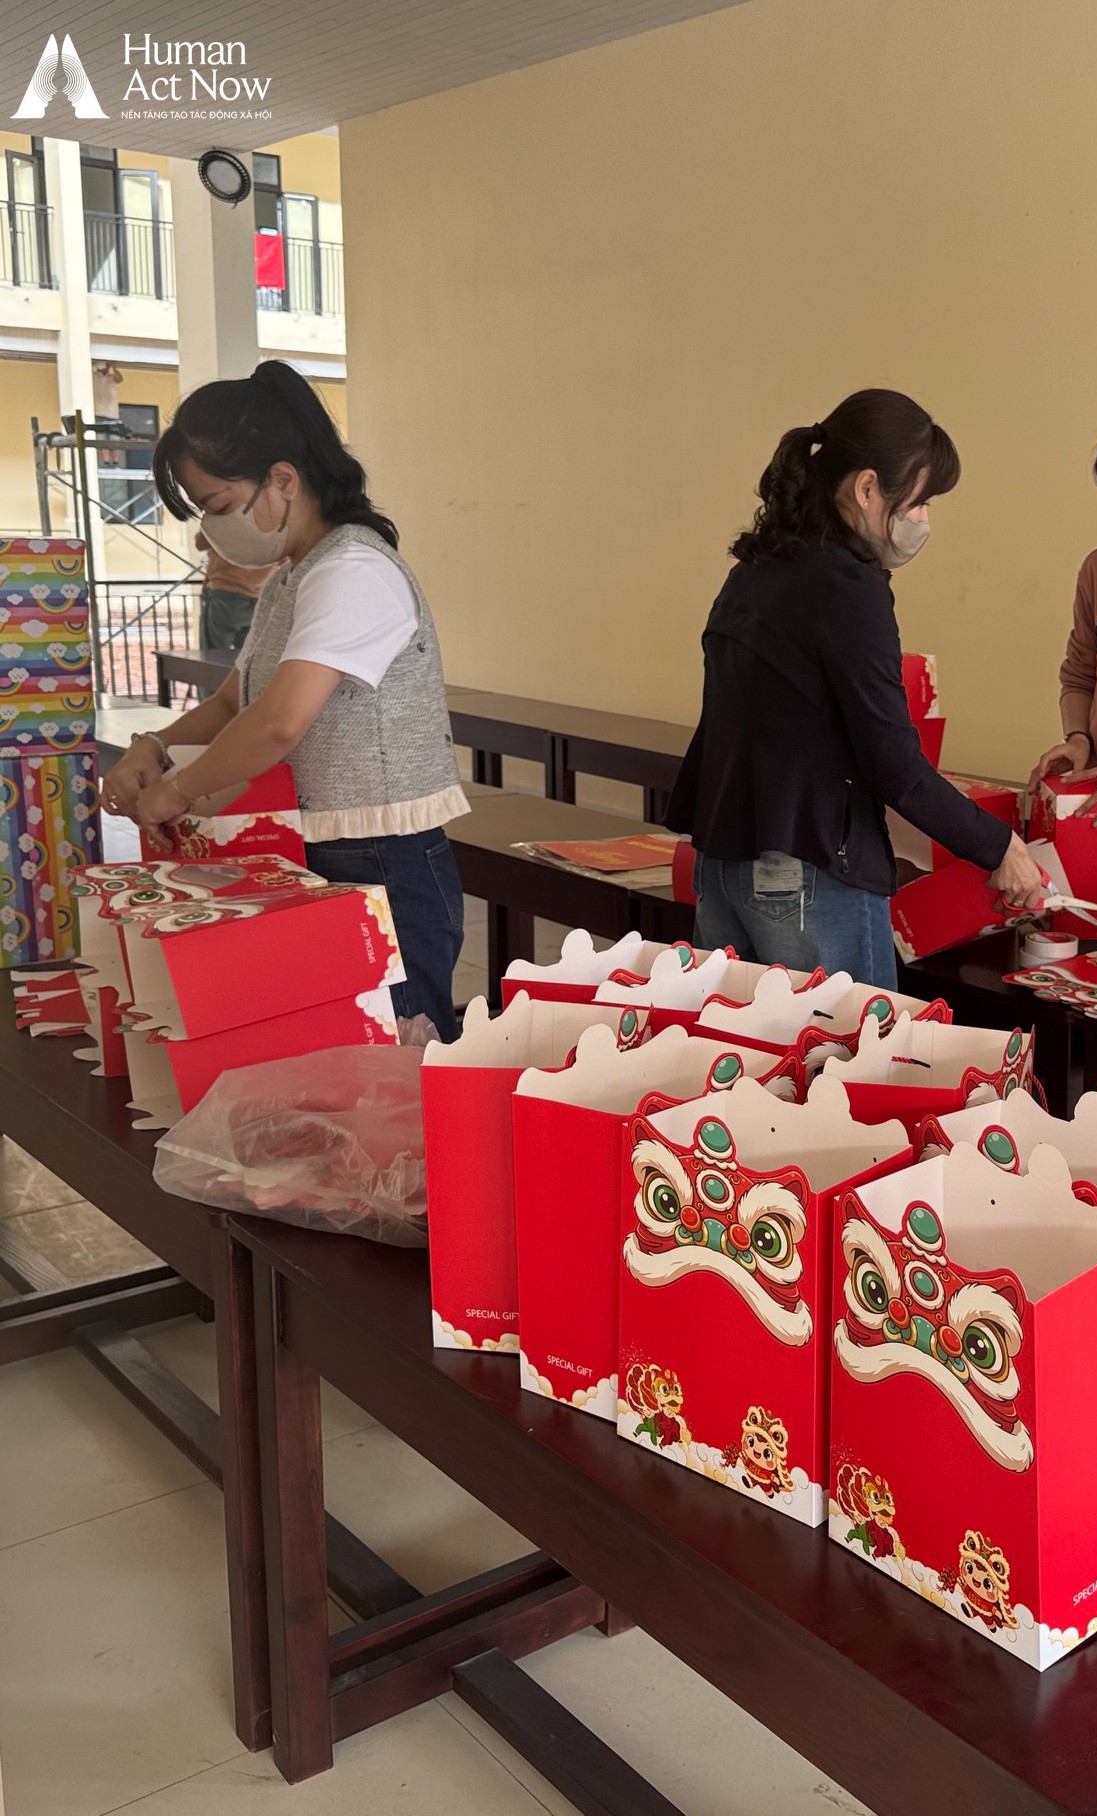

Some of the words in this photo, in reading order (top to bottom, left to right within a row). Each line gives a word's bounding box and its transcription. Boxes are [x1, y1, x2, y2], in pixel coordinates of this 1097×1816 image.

[360, 922, 370, 938] GIFT
[365, 937, 376, 964] SPECIAL
[466, 1308, 501, 1320] SPECIAL
[547, 1354, 577, 1373] SPECIAL
[576, 1365, 594, 1378] GIFT
